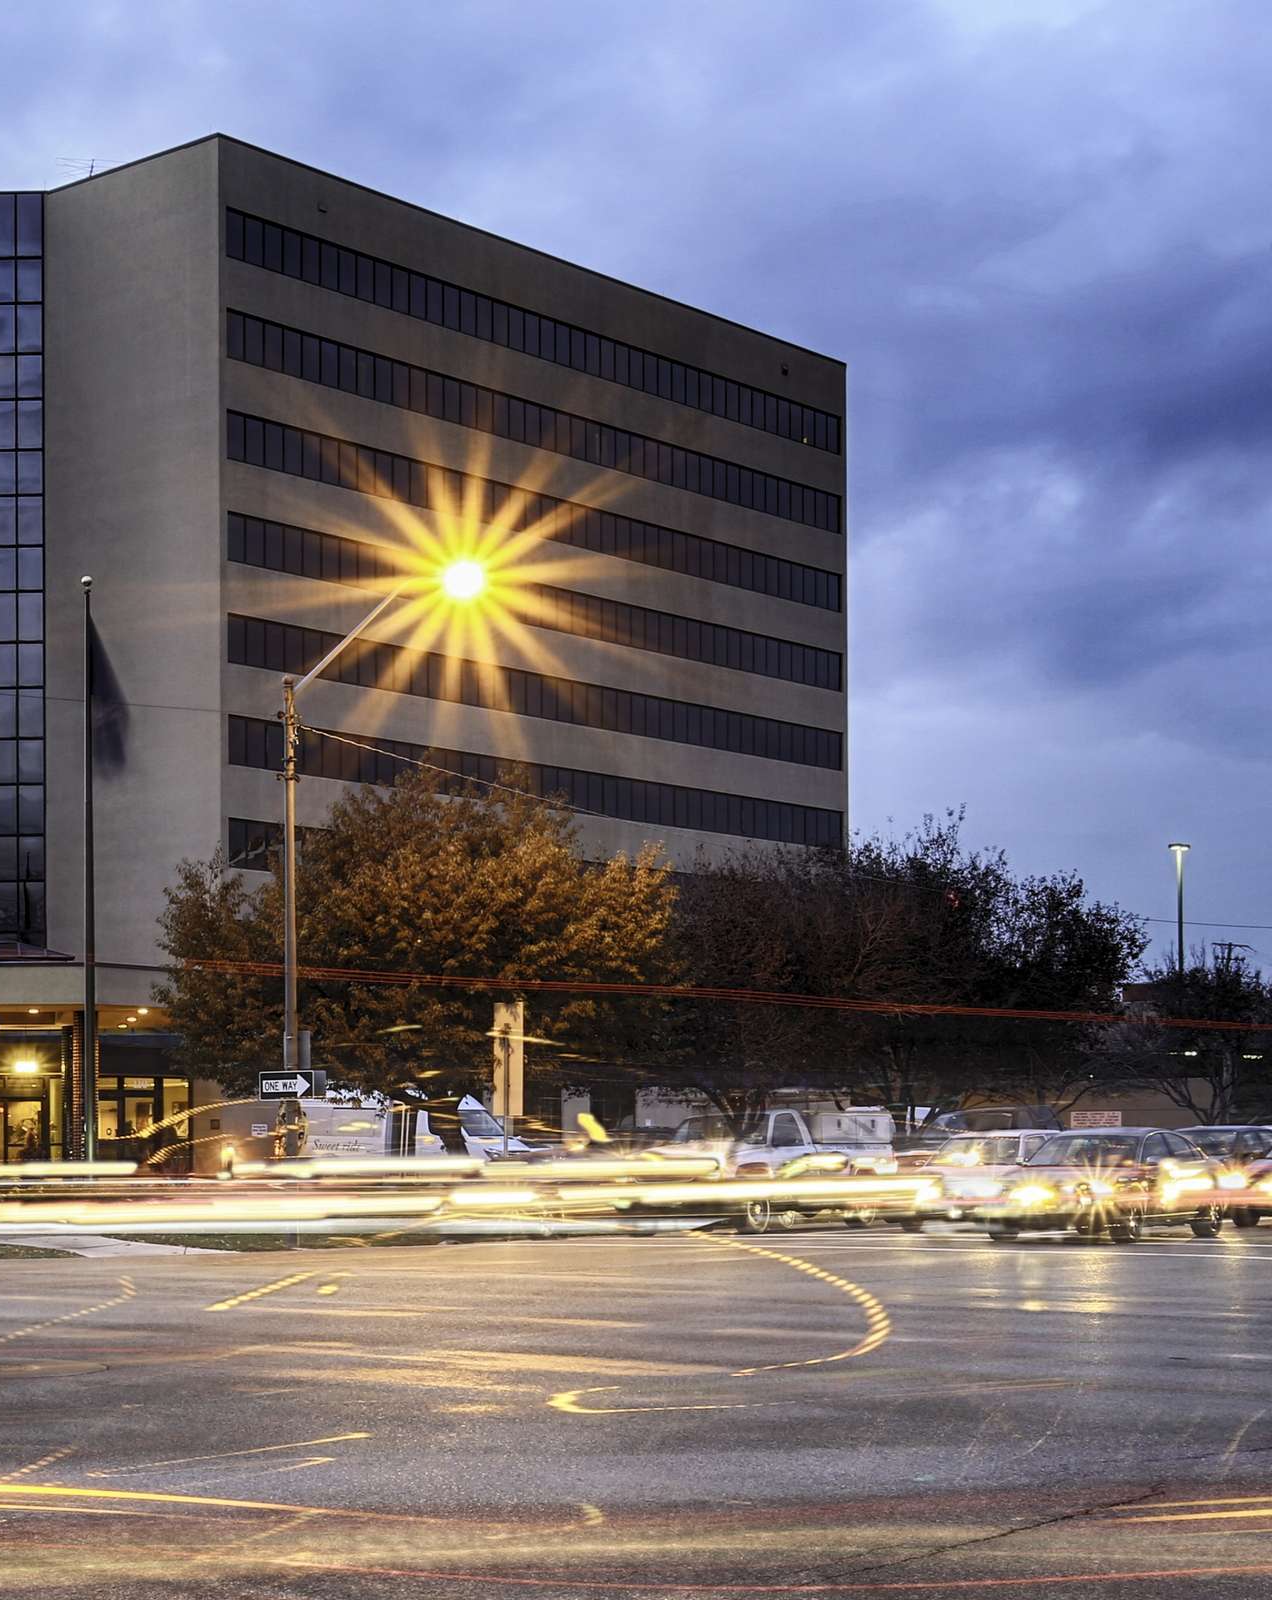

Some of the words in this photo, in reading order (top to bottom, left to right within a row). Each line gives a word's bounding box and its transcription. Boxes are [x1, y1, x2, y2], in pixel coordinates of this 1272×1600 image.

[264, 1081, 279, 1091] ONE
[282, 1081, 298, 1091] WAY
[312, 1139, 340, 1151] Sweet
